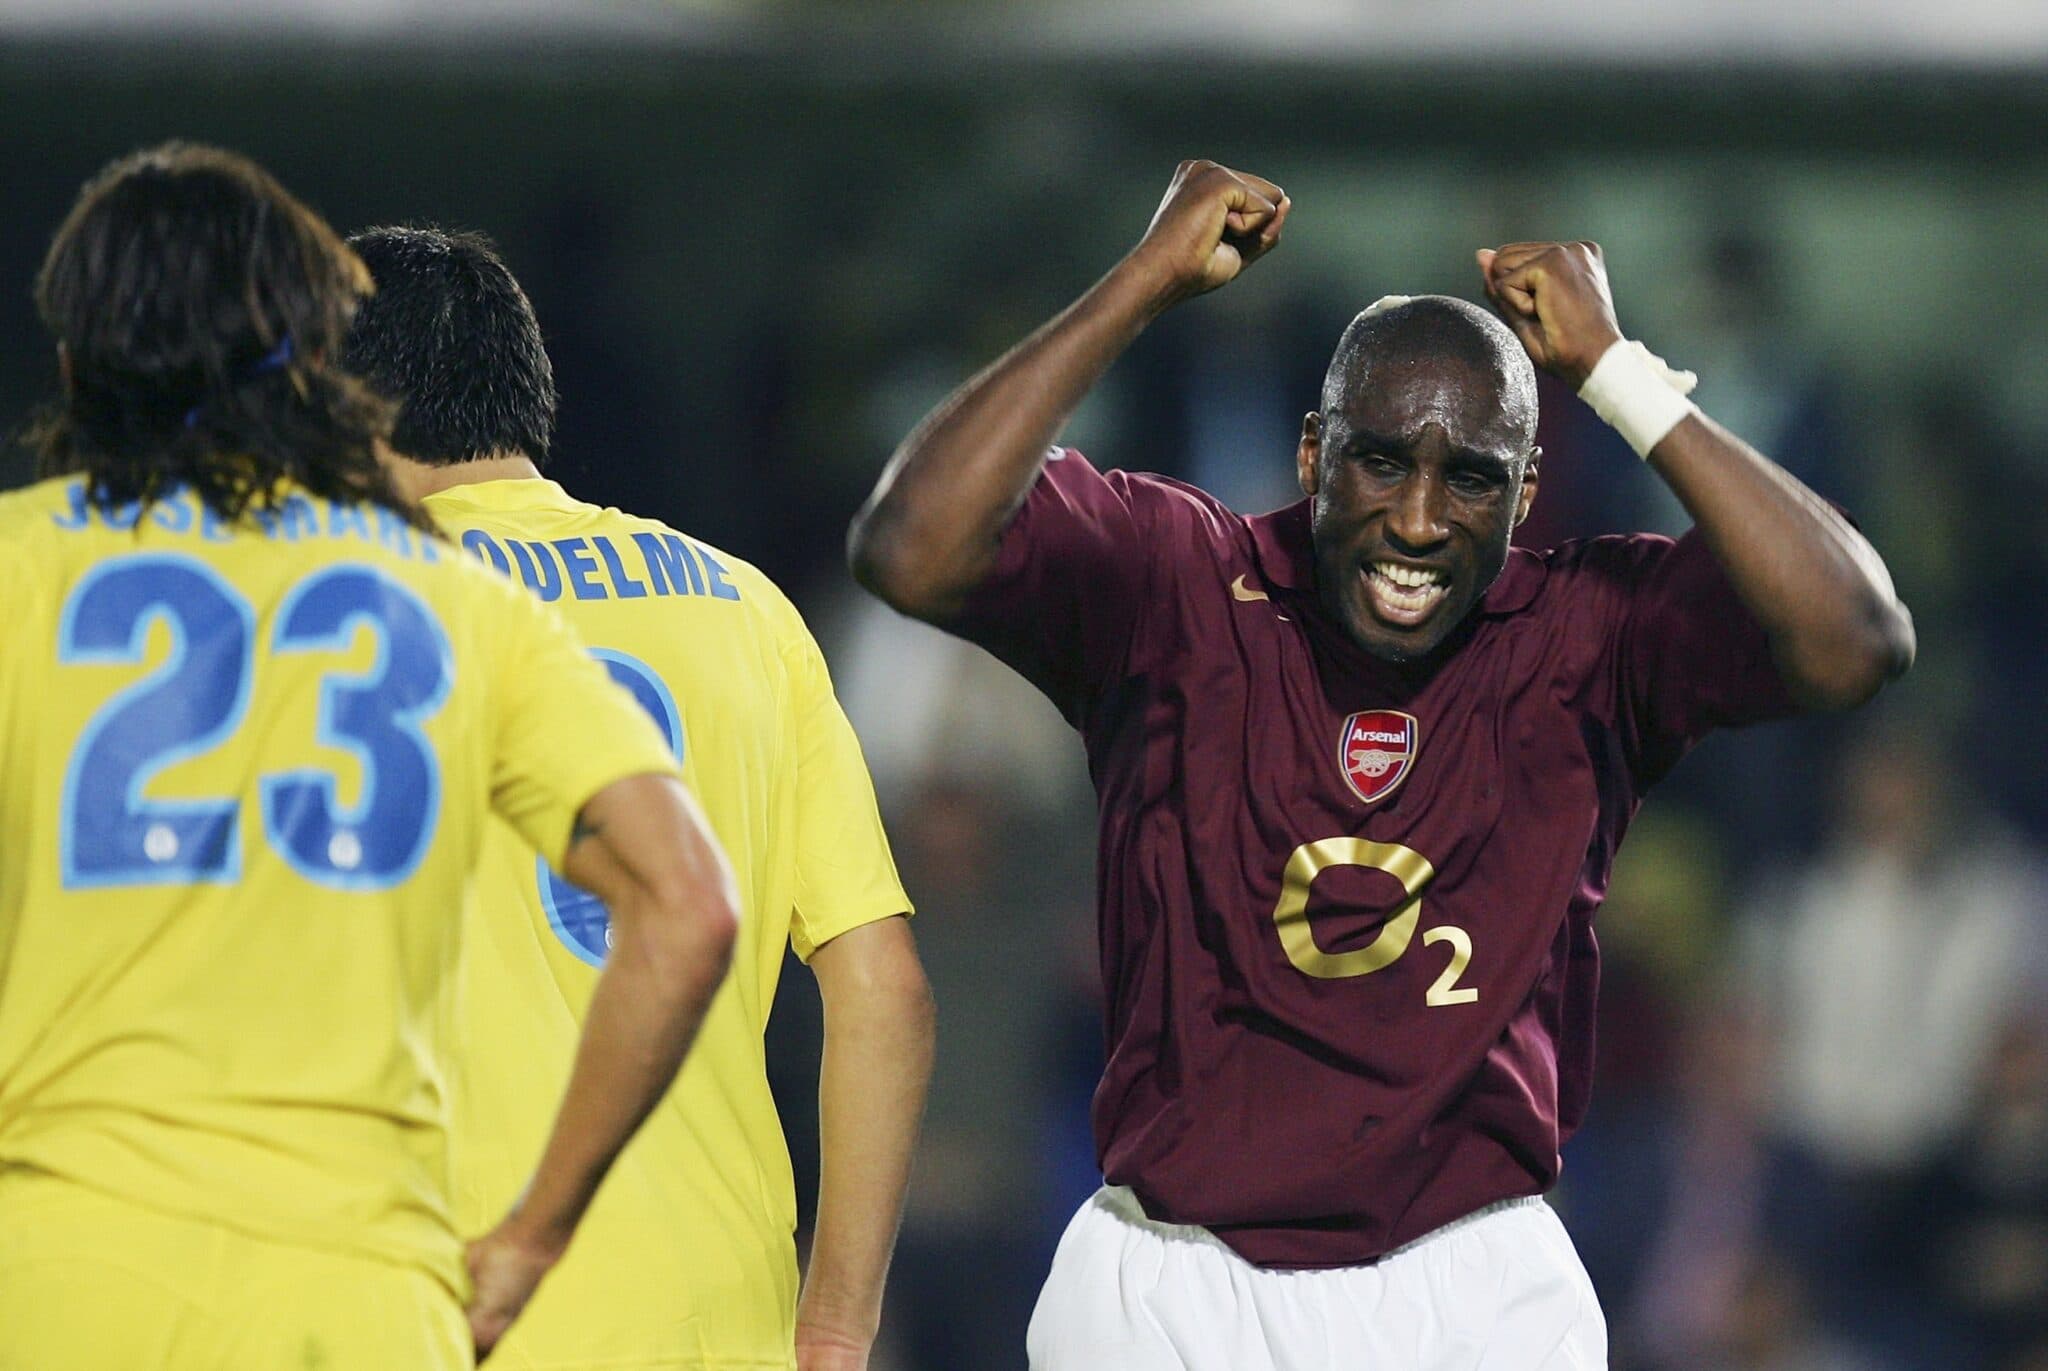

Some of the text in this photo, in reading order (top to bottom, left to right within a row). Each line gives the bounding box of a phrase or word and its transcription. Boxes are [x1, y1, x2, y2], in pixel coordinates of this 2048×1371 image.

[461, 529, 740, 602] QUELME
[58, 551, 455, 892] 23
[1352, 728, 1405, 743] Arsenal
